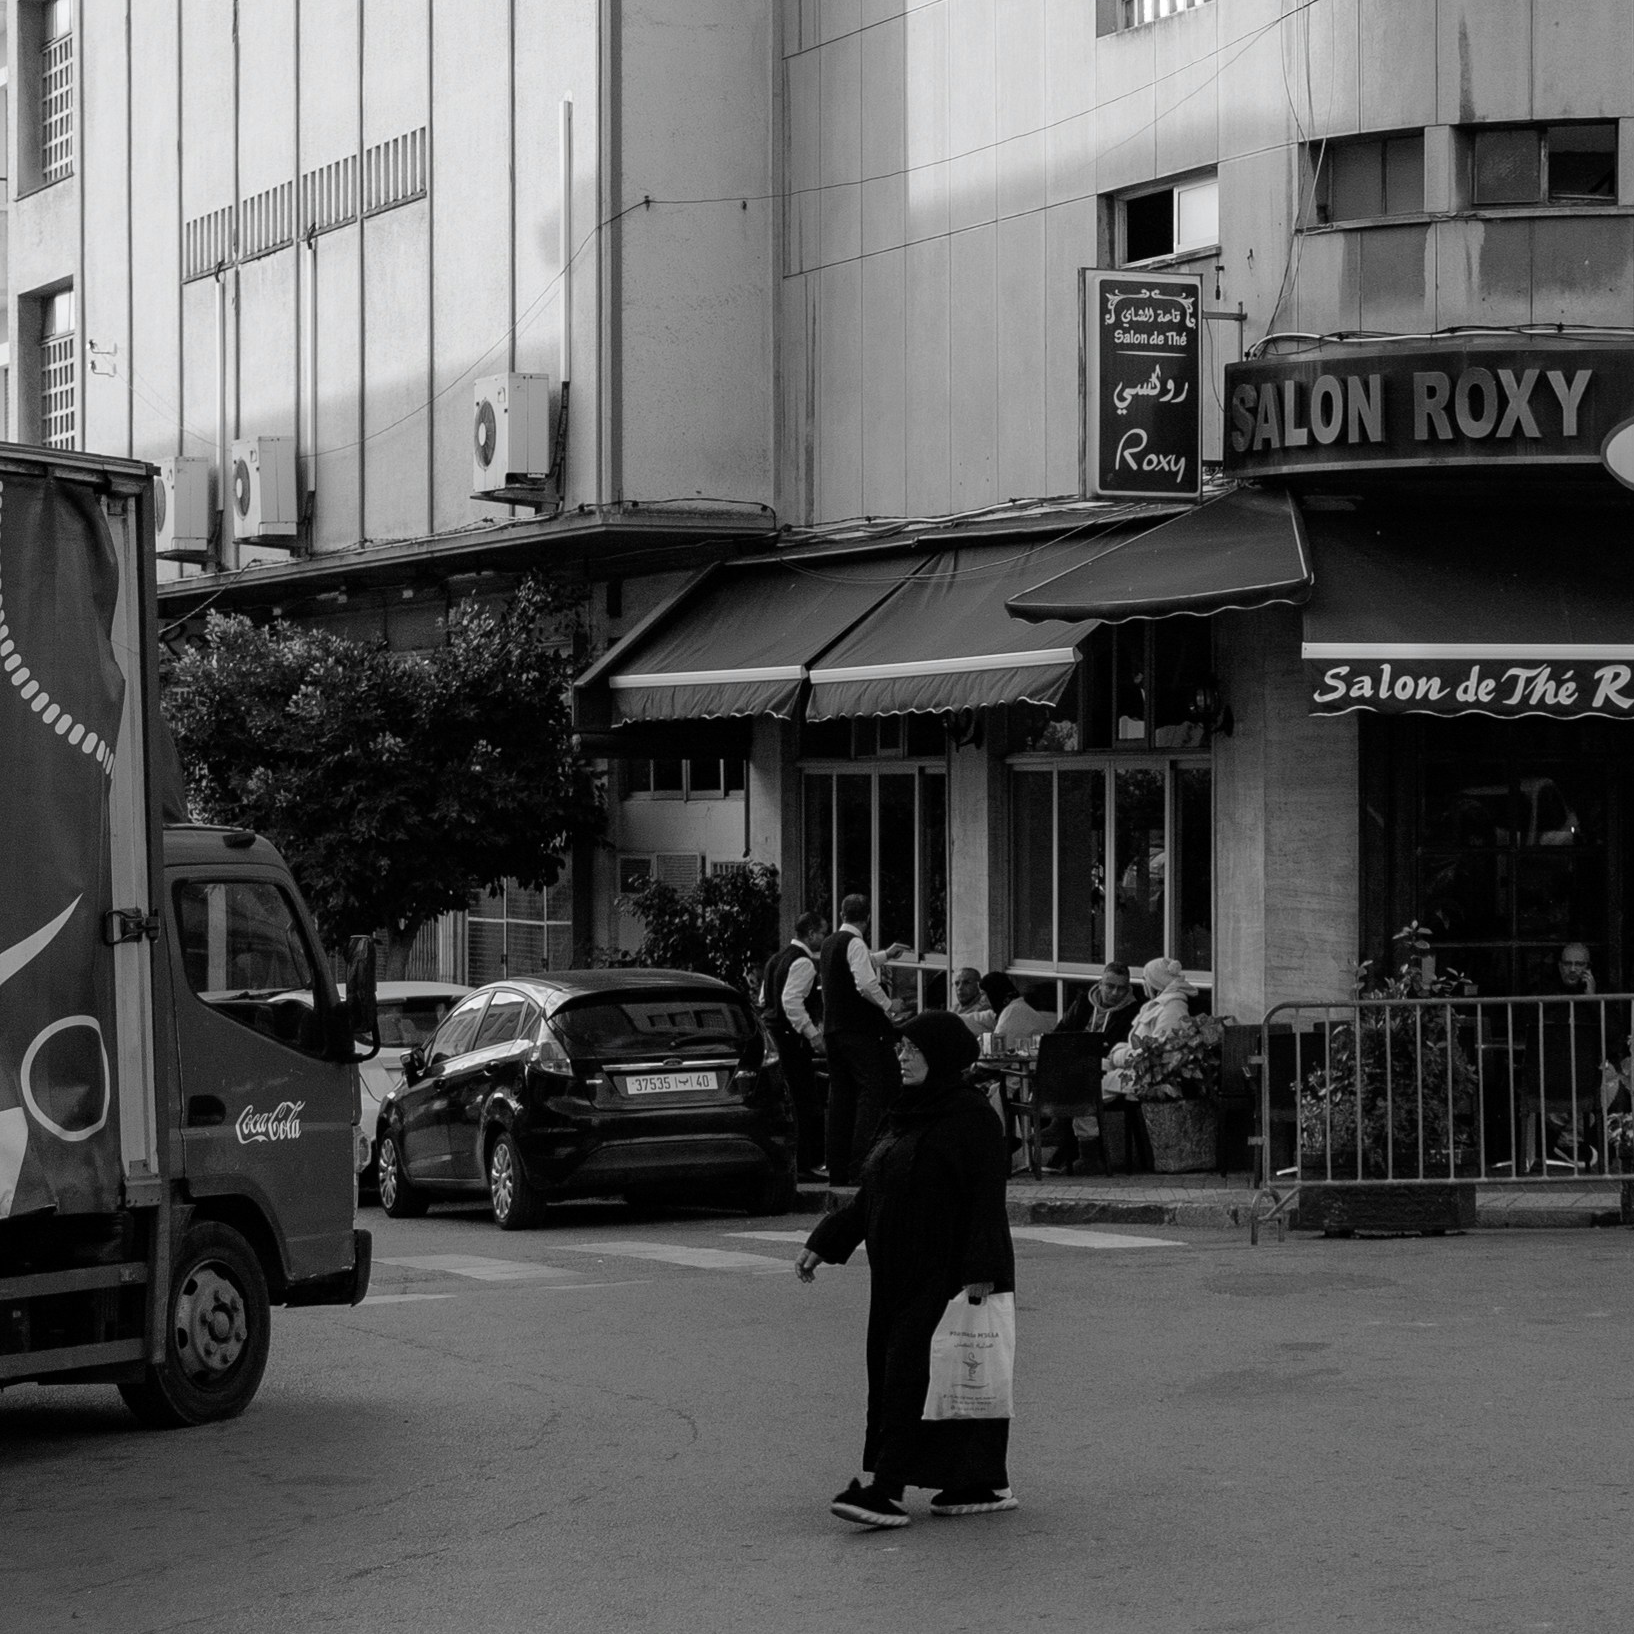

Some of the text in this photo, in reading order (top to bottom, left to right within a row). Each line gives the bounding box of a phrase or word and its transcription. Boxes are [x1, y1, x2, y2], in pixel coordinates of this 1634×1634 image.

[1114, 329, 1187, 346] Salon de Thé
[1120, 306, 1181, 328] قاعة الشاي
[1113, 363, 1189, 416] روكسي
[1231, 365, 1594, 453] SALON ROXY
[1114, 427, 1186, 484] Roxy
[1313, 663, 1452, 703] Salon
[1454, 663, 1497, 703] de
[1499, 662, 1579, 705] Thé
[634, 1076, 671, 1092] 37535
[696, 1074, 710, 1088] 40
